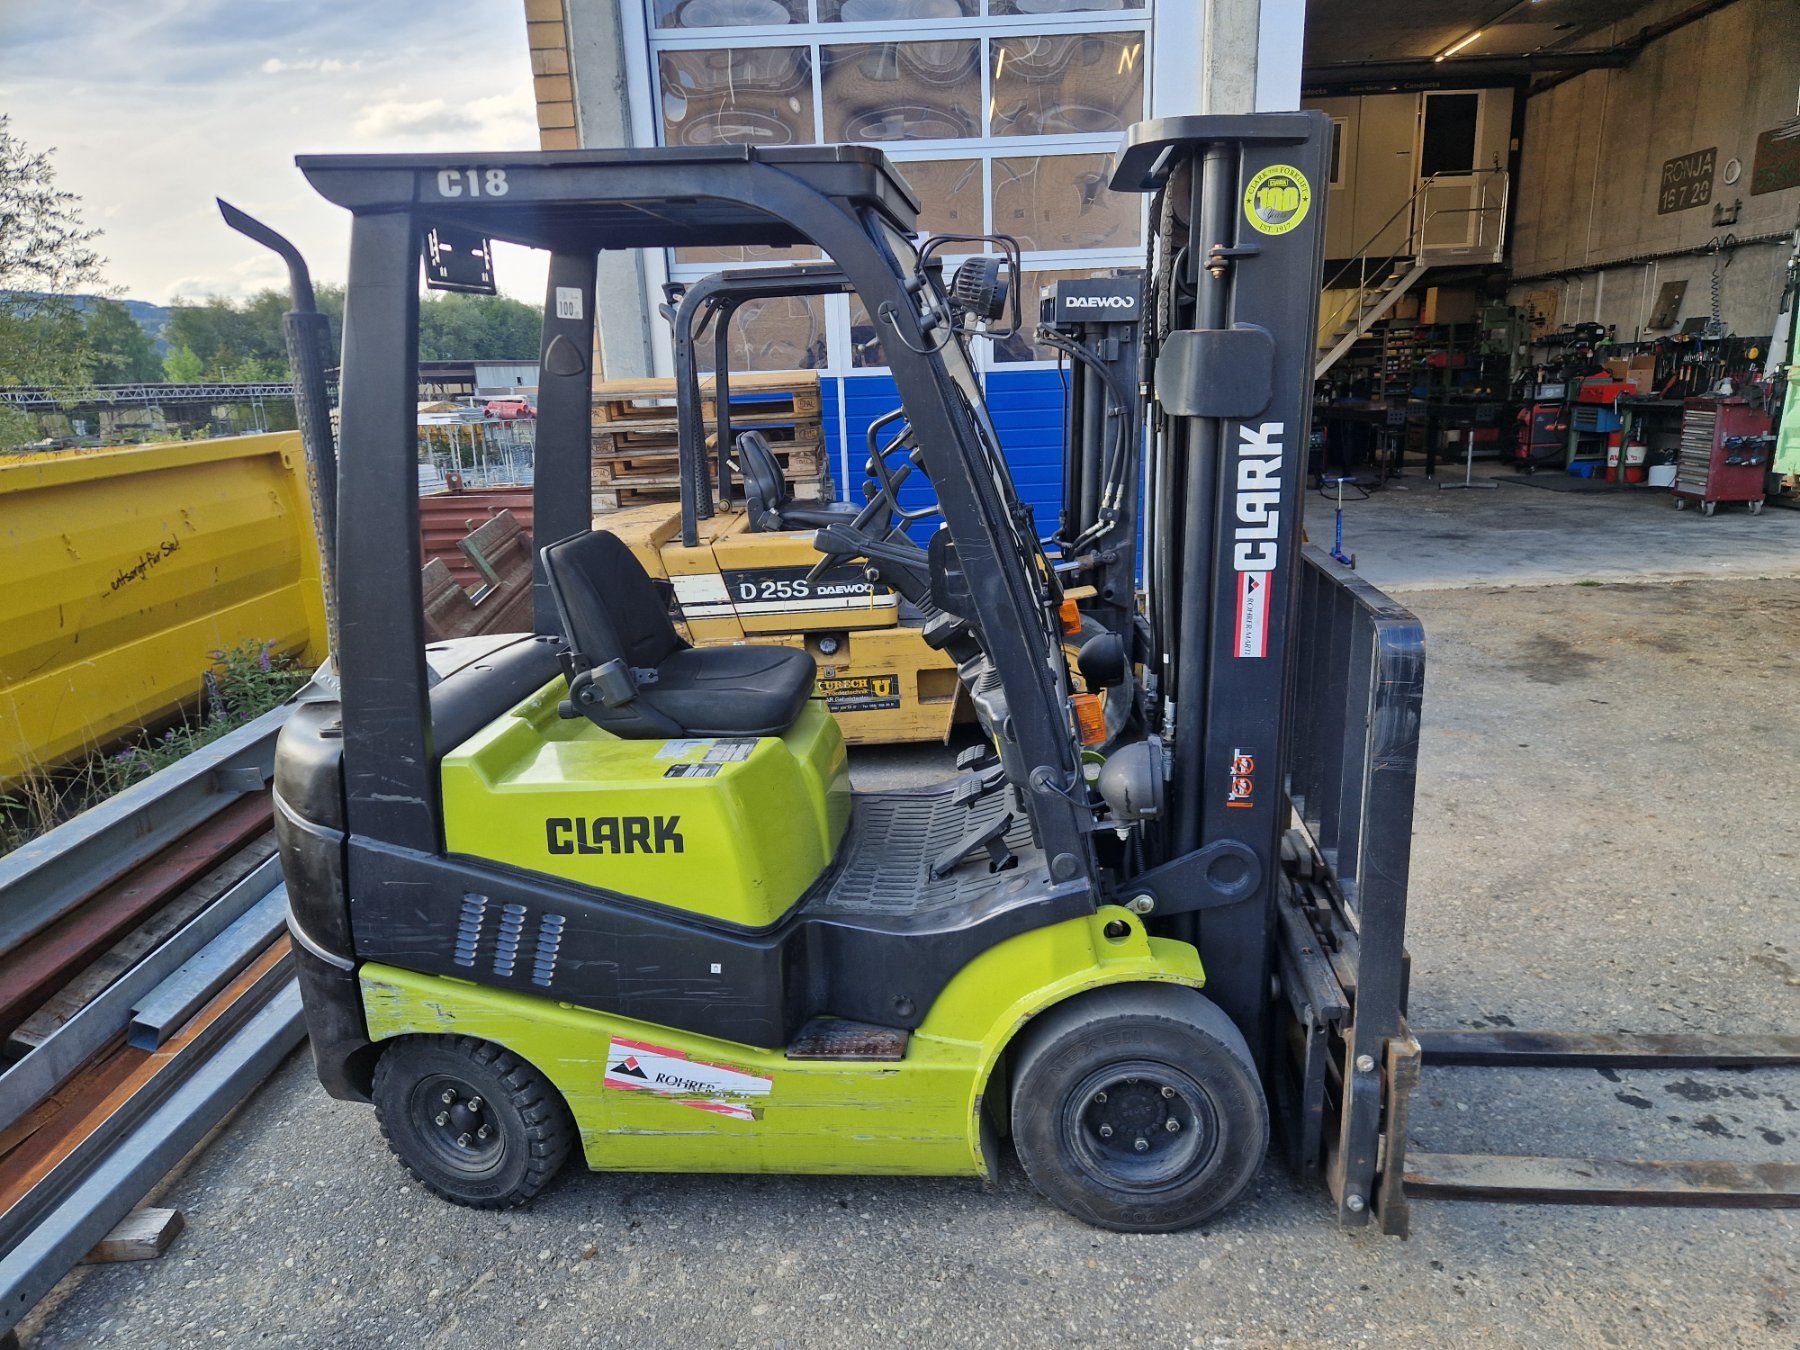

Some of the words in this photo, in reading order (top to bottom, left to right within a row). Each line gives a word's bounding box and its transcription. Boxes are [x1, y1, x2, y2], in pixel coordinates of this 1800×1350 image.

[1248, 171, 1267, 194] CLARK
[1280, 166, 1308, 192] FORKLIFT
[1663, 152, 1713, 184] RONJA
[437, 169, 509, 197] C18
[1680, 186, 1688, 206] 7
[1691, 180, 1709, 203] 20
[1257, 187, 1299, 211] 100
[1276, 222, 1291, 233] 1917
[559, 301, 573, 316] 100
[1065, 296, 1135, 308] DAEWOO
[1233, 421, 1285, 572] CLARK
[740, 583, 757, 600] D
[761, 579, 810, 599] 25S
[816, 582, 875, 596] DAEWOO
[872, 678, 891, 697] U
[545, 815, 685, 855] CLARK
